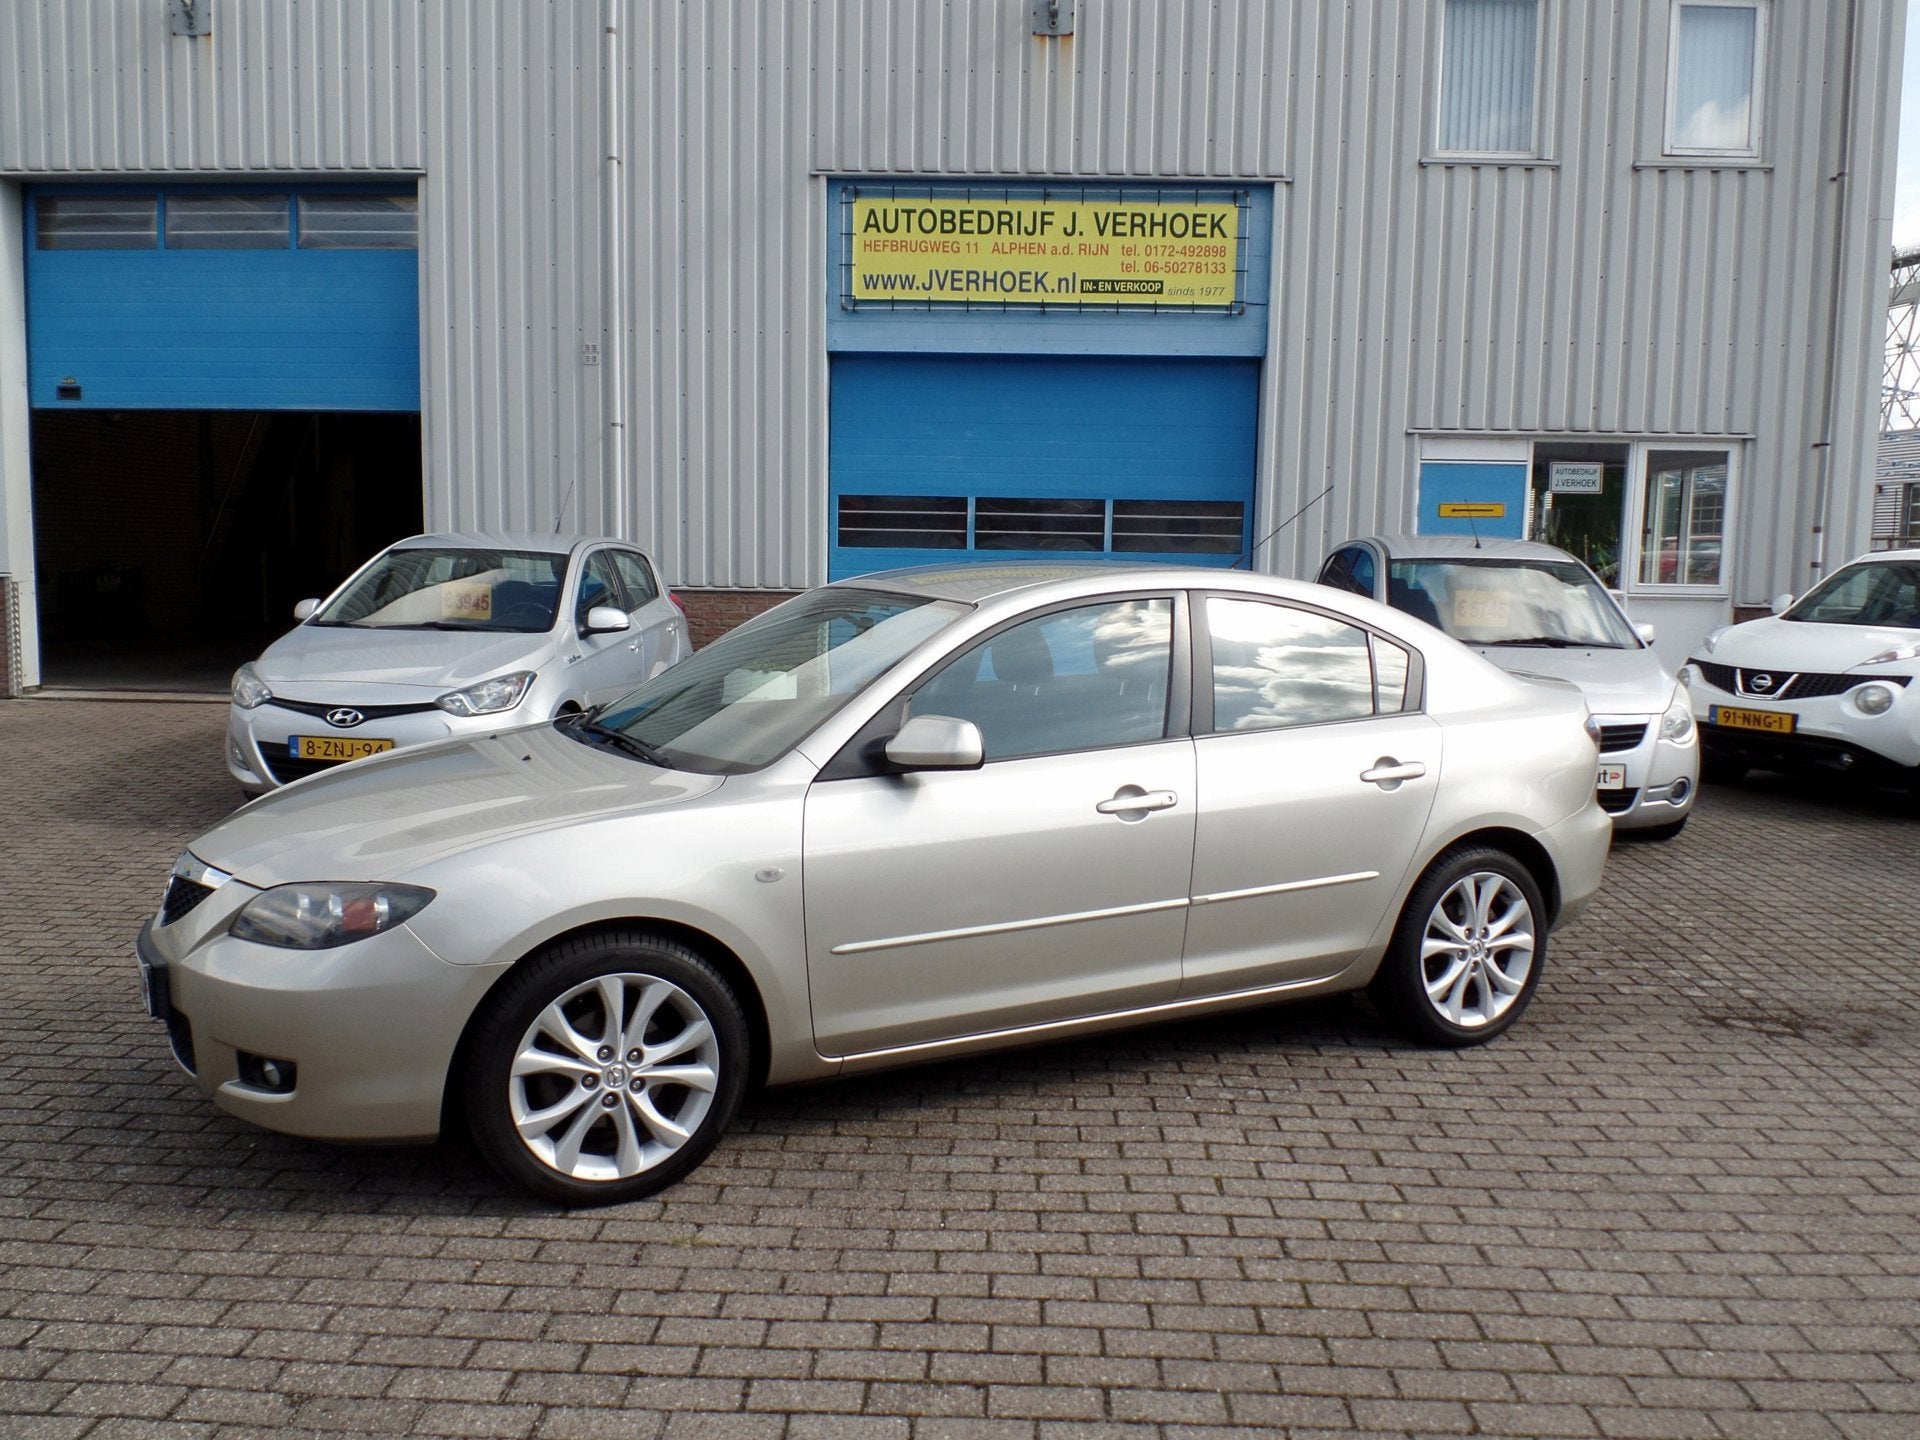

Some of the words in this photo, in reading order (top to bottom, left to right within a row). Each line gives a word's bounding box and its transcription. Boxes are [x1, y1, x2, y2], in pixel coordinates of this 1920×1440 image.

[863, 208, 1055, 236] AUTOBEDRIJF
[1063, 211, 1084, 237] J.
[1093, 211, 1228, 239] VERHOEK
[863, 239, 960, 253] HEFBRUGWEG
[965, 241, 979, 254] 11
[991, 241, 1046, 255] ALPHEN
[1050, 243, 1074, 256] a.d.
[1078, 243, 1110, 256] RIJN
[1121, 244, 1140, 257] tel.
[1144, 244, 1227, 258] 0172-492898
[1120, 260, 1140, 273] tel.
[1144, 261, 1226, 274] 06-50278133
[862, 268, 1076, 294] www.JVERHOEK.nl
[1083, 281, 1097, 291] IN-
[1098, 281, 1112, 292] EN
[1113, 281, 1162, 293] VERKOOP
[1167, 286, 1195, 296] sinds
[1199, 287, 1225, 297] 1977
[1555, 467, 1598, 476] AUTOBEDRIJF
[1554, 479, 1598, 488] J.VERHOEK
[1722, 710, 1785, 730] 91-NNG-1
[306, 740, 384, 757] 8-ZNJ-94
